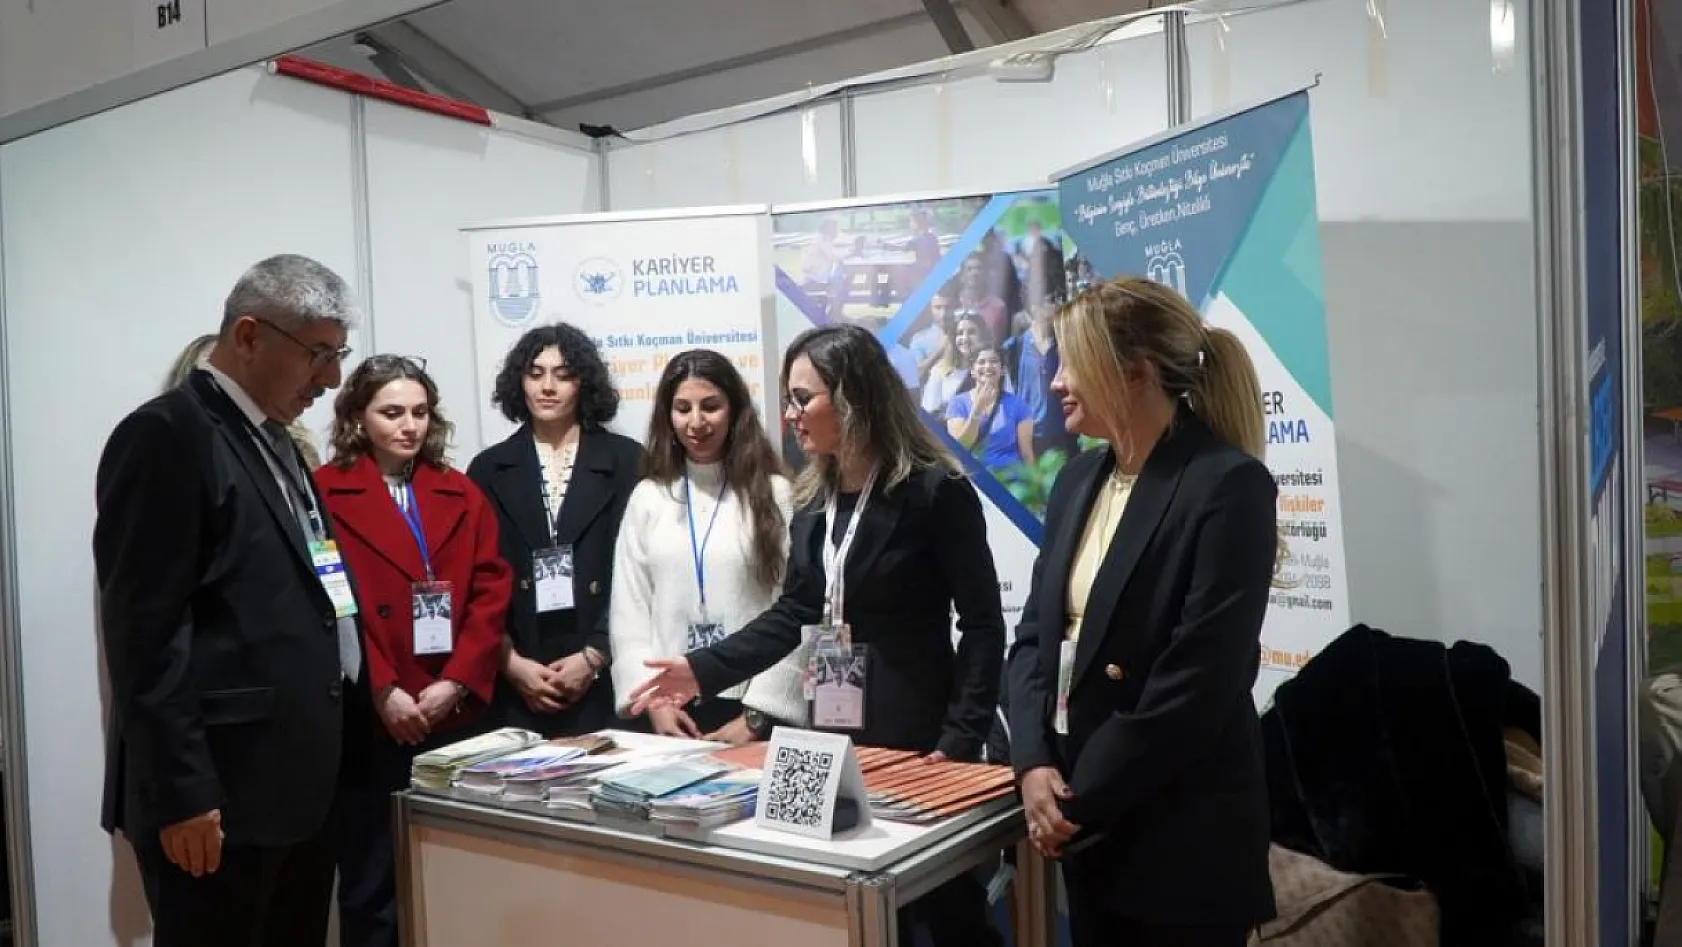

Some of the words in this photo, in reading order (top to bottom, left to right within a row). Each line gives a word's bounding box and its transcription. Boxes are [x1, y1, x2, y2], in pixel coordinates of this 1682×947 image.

[157, 0, 181, 28] B14
[1170, 130, 1229, 165] Üniversitesi
[487, 242, 536, 253] MUĞLA
[1145, 238, 1182, 257] MUĞLA
[632, 253, 714, 276] KARİYER
[633, 275, 740, 297] PLANLAMA
[607, 333, 634, 348] Sıtkı
[636, 333, 682, 348] Koçman
[687, 328, 757, 345] Üniversitesi
[1266, 420, 1309, 444] AMA
